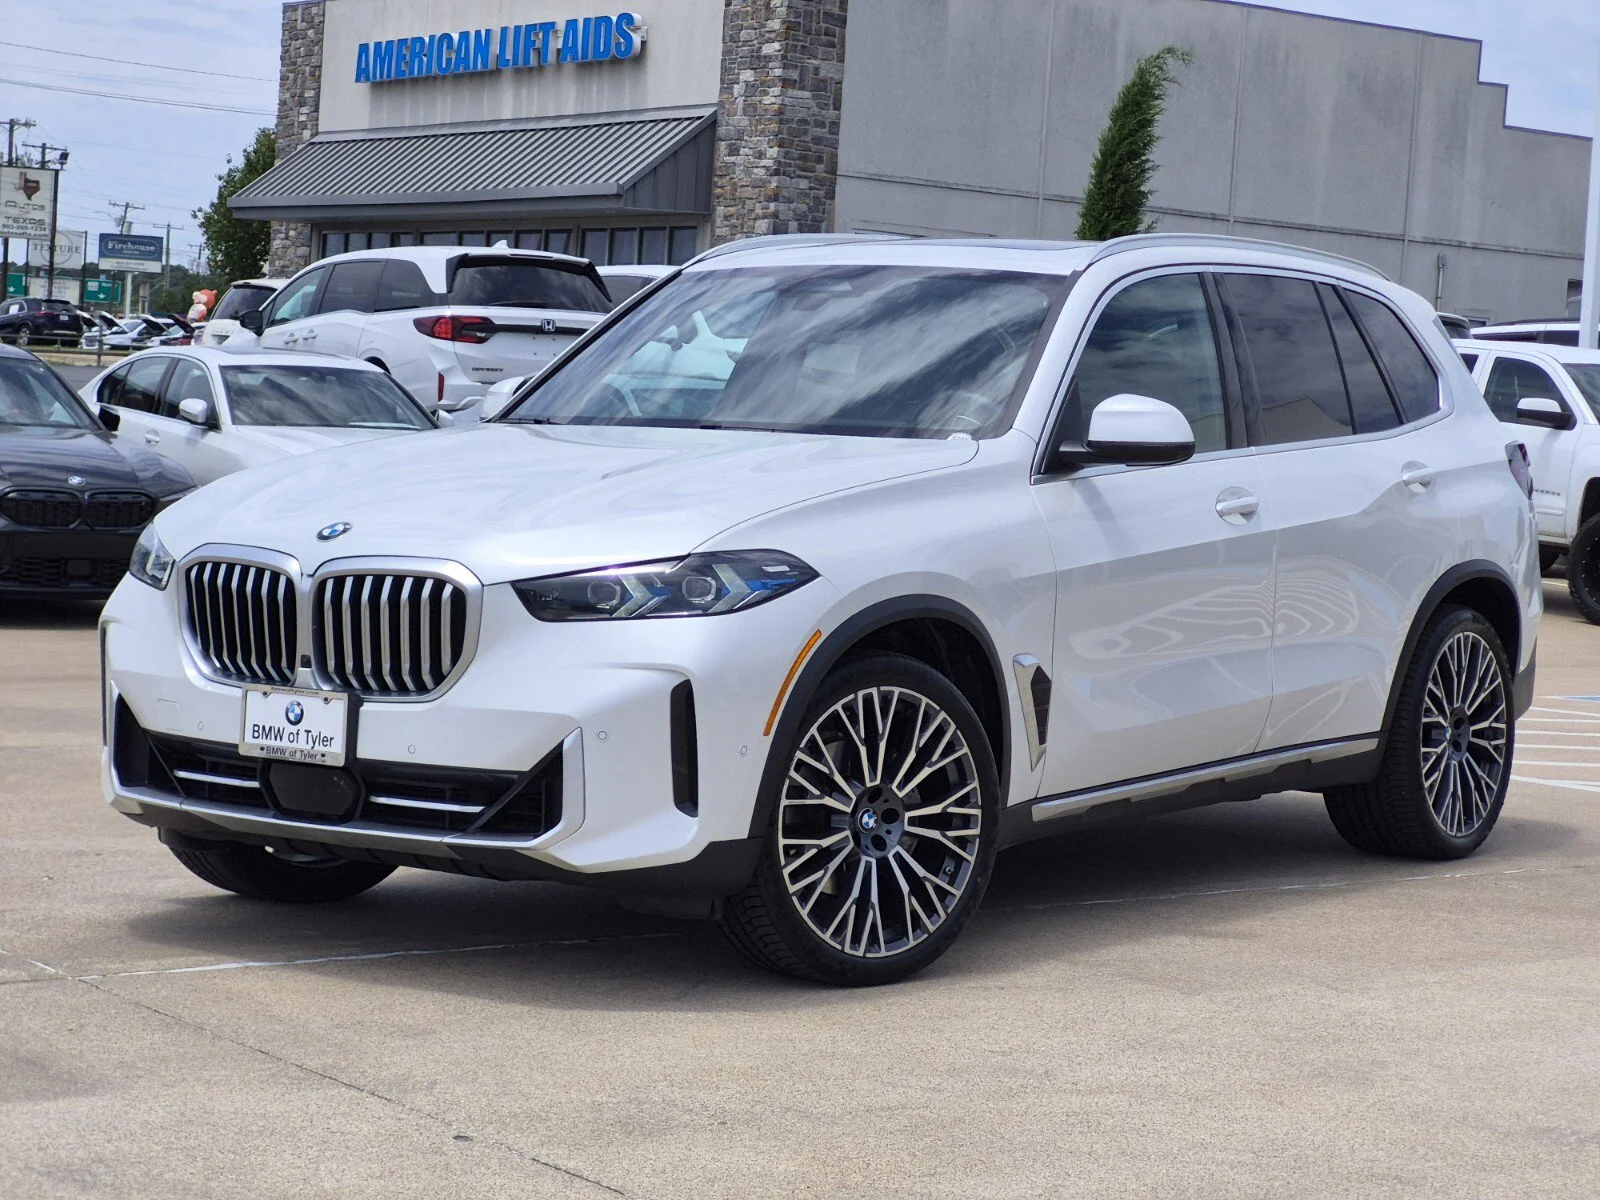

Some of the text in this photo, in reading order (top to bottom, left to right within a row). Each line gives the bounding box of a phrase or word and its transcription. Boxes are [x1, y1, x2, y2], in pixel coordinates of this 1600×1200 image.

[355, 12, 641, 83] AMERICAN LIFT AIDS
[107, 240, 156, 251] Firehouse
[252, 724, 334, 750] BMW of Tyler
[265, 746, 288, 757] BMW
[289, 749, 298, 758] of
[299, 750, 319, 761] Tyler
